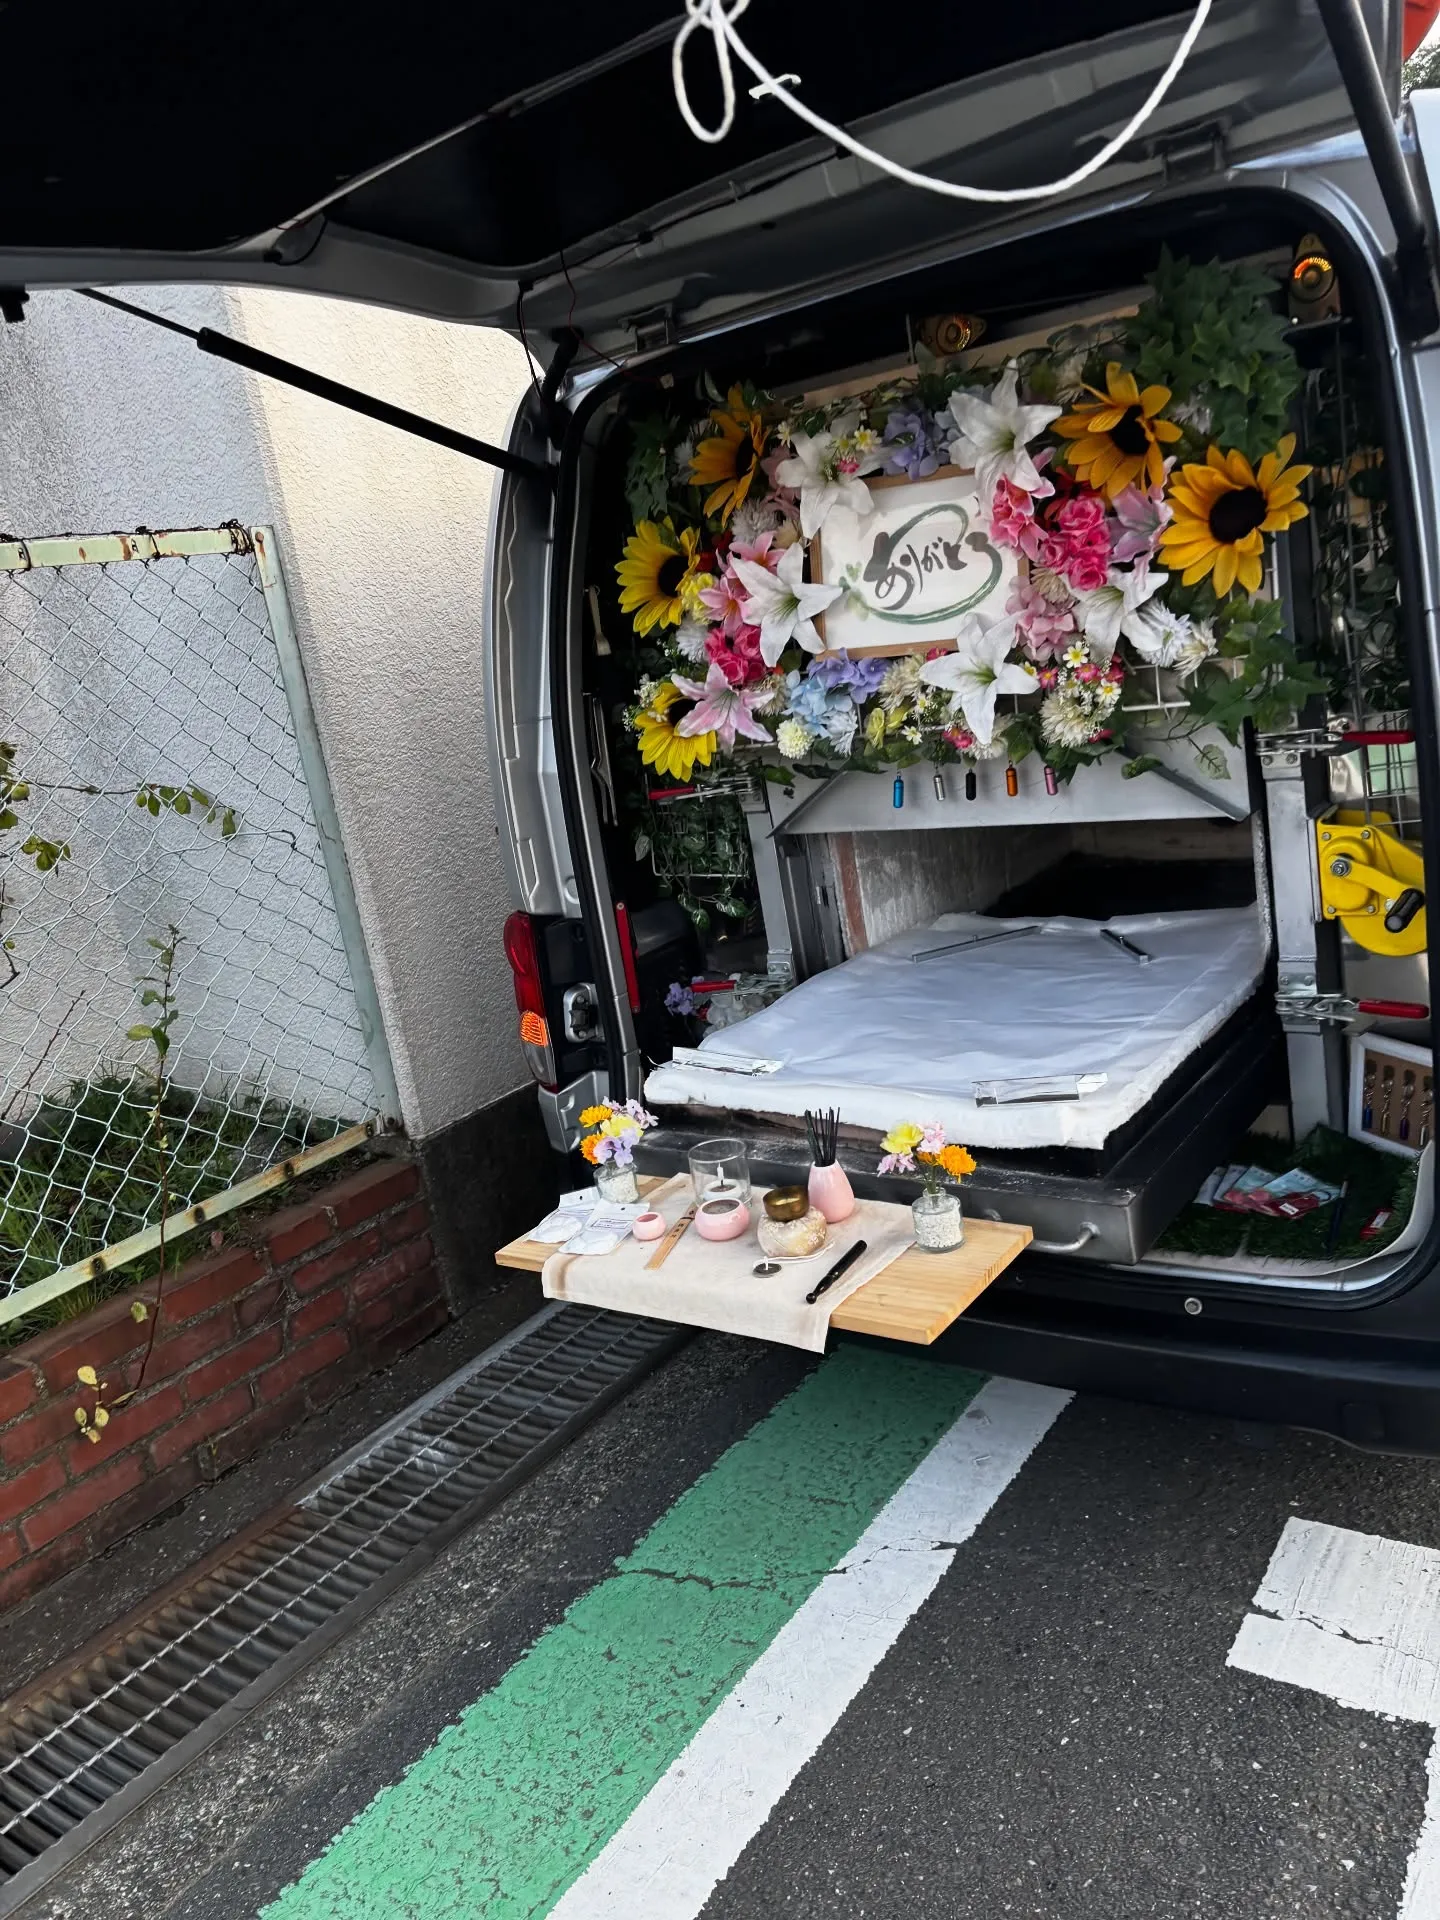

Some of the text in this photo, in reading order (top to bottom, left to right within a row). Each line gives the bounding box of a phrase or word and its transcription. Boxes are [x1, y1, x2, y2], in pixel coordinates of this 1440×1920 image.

[863, 500, 1003, 624] ありがとう
